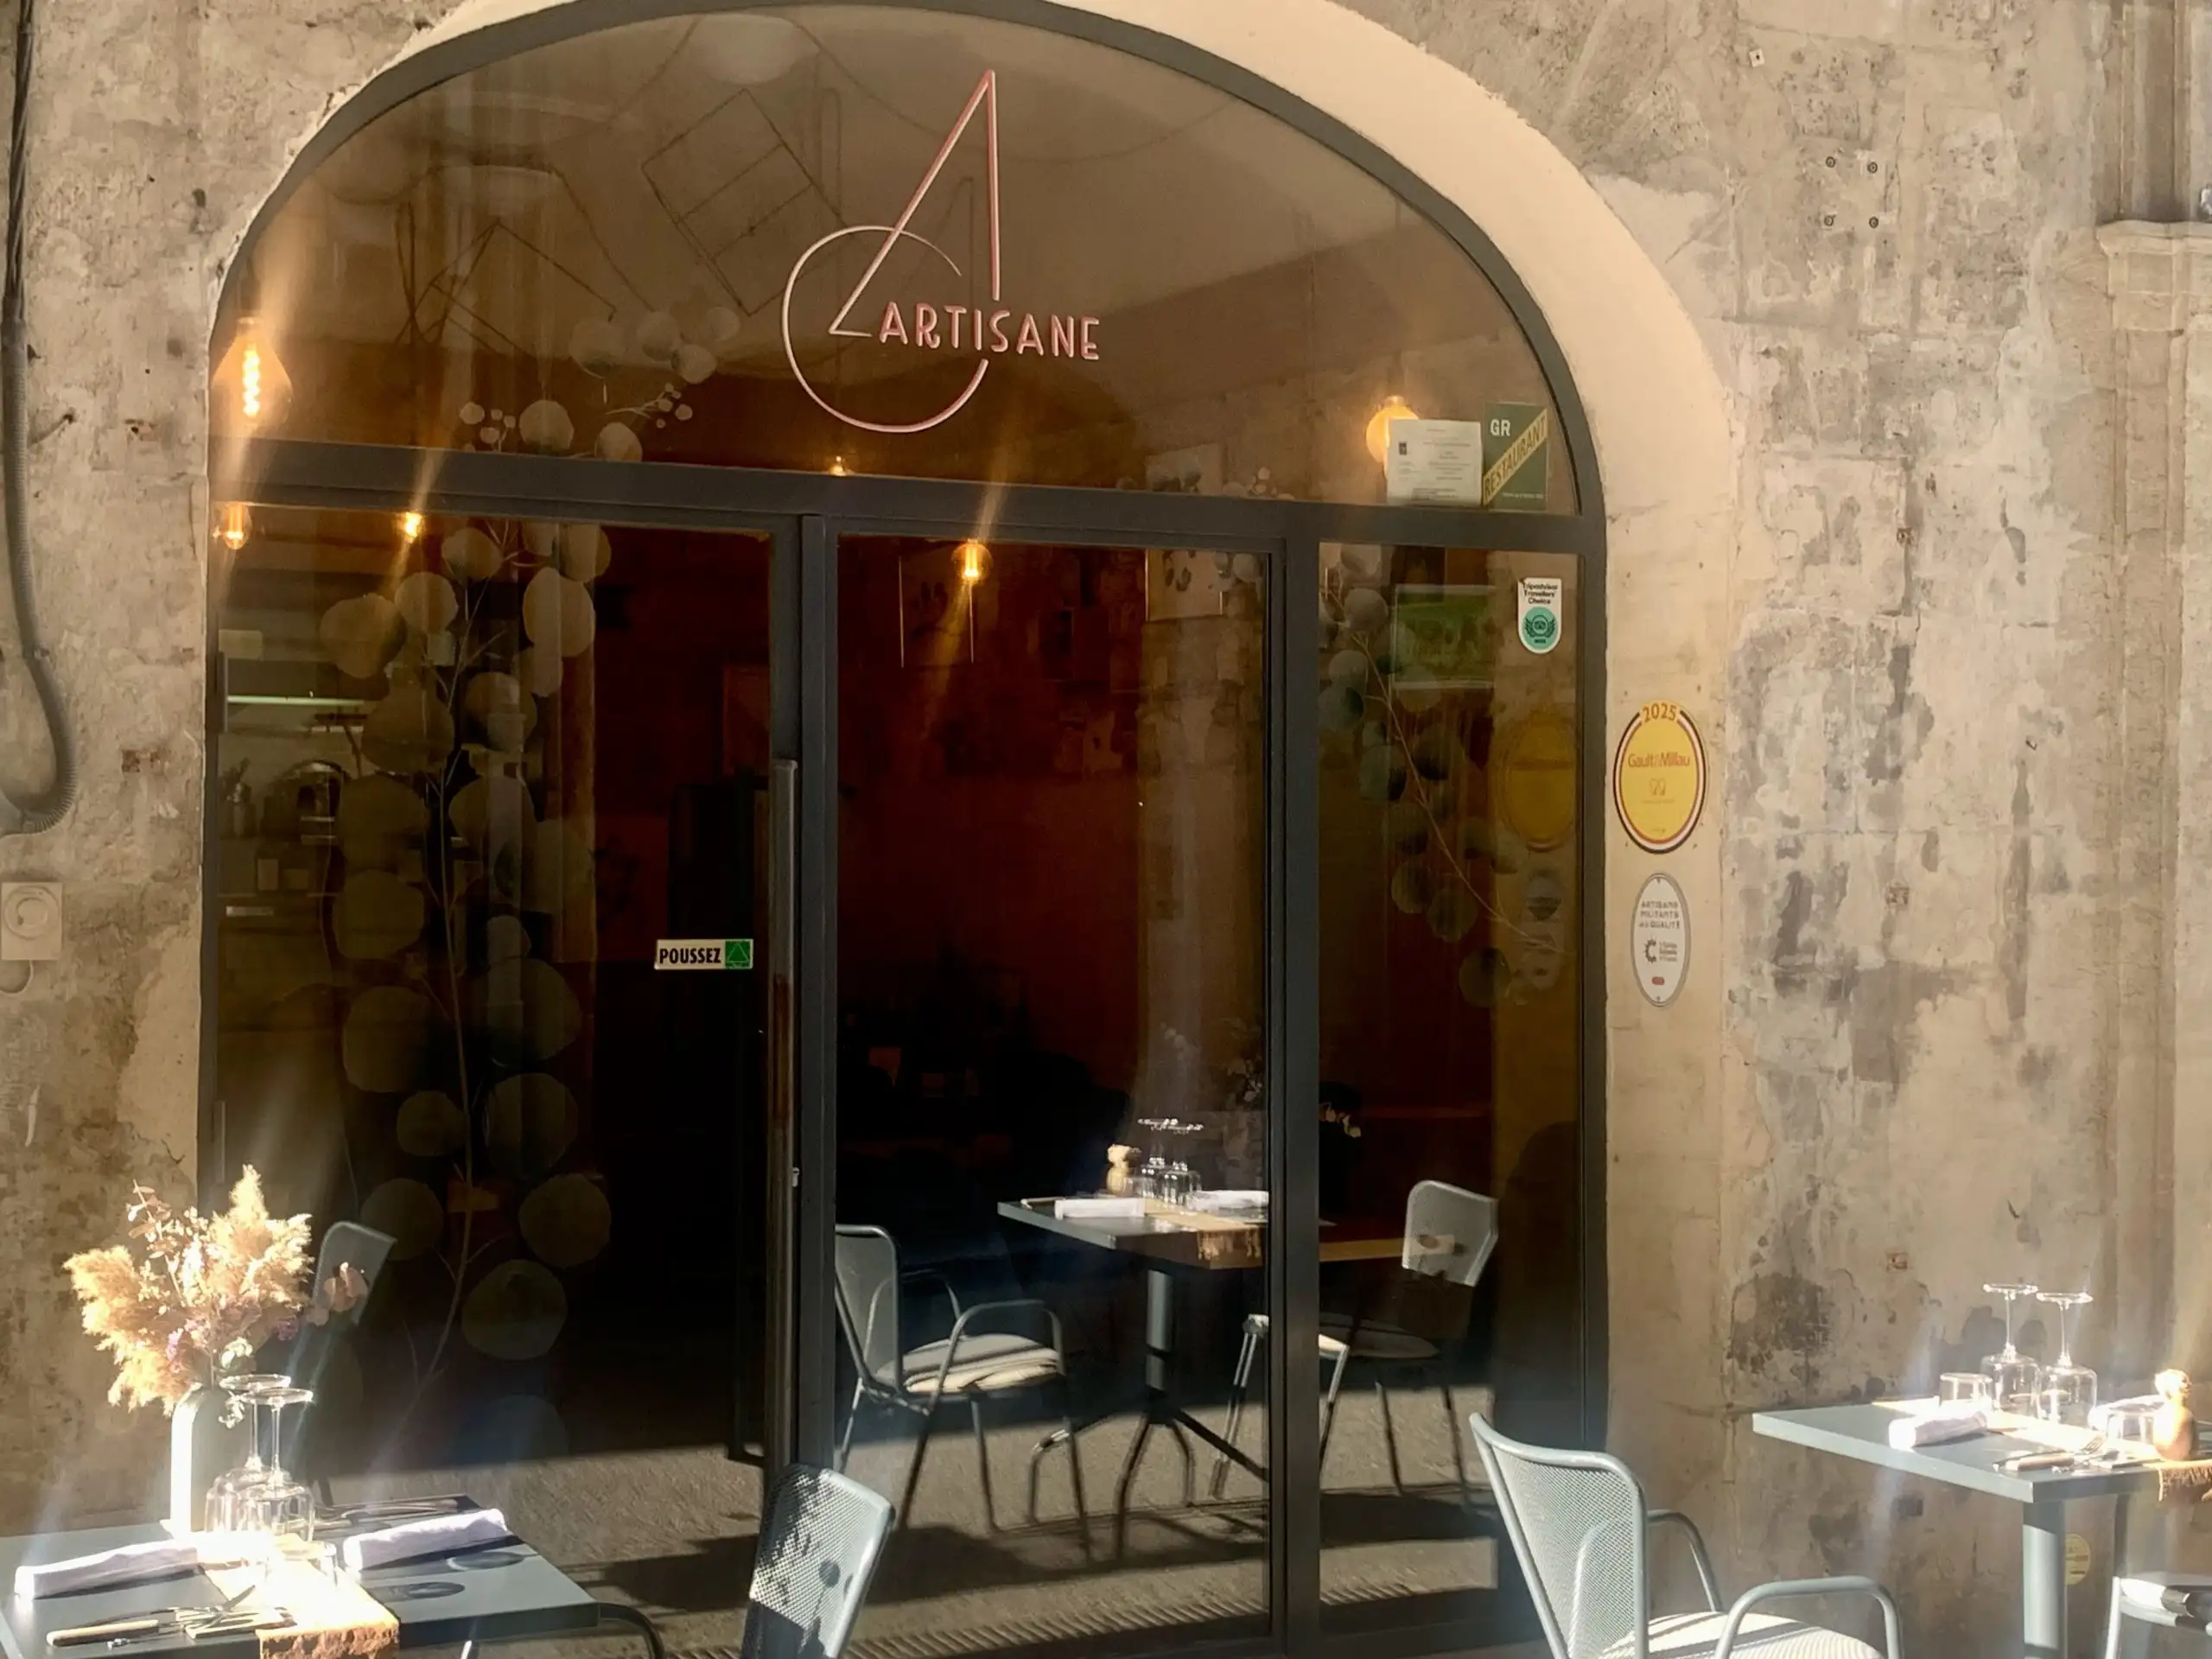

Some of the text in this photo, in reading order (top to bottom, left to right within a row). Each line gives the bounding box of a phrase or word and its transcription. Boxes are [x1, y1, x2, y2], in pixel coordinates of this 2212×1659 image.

[880, 302, 1099, 360] ARTISANE
[1491, 418, 1510, 436] GR
[1484, 416, 1545, 503] RESTAURANT
[1643, 702, 1677, 722] 2025
[659, 948, 721, 963] POUSSEZ
